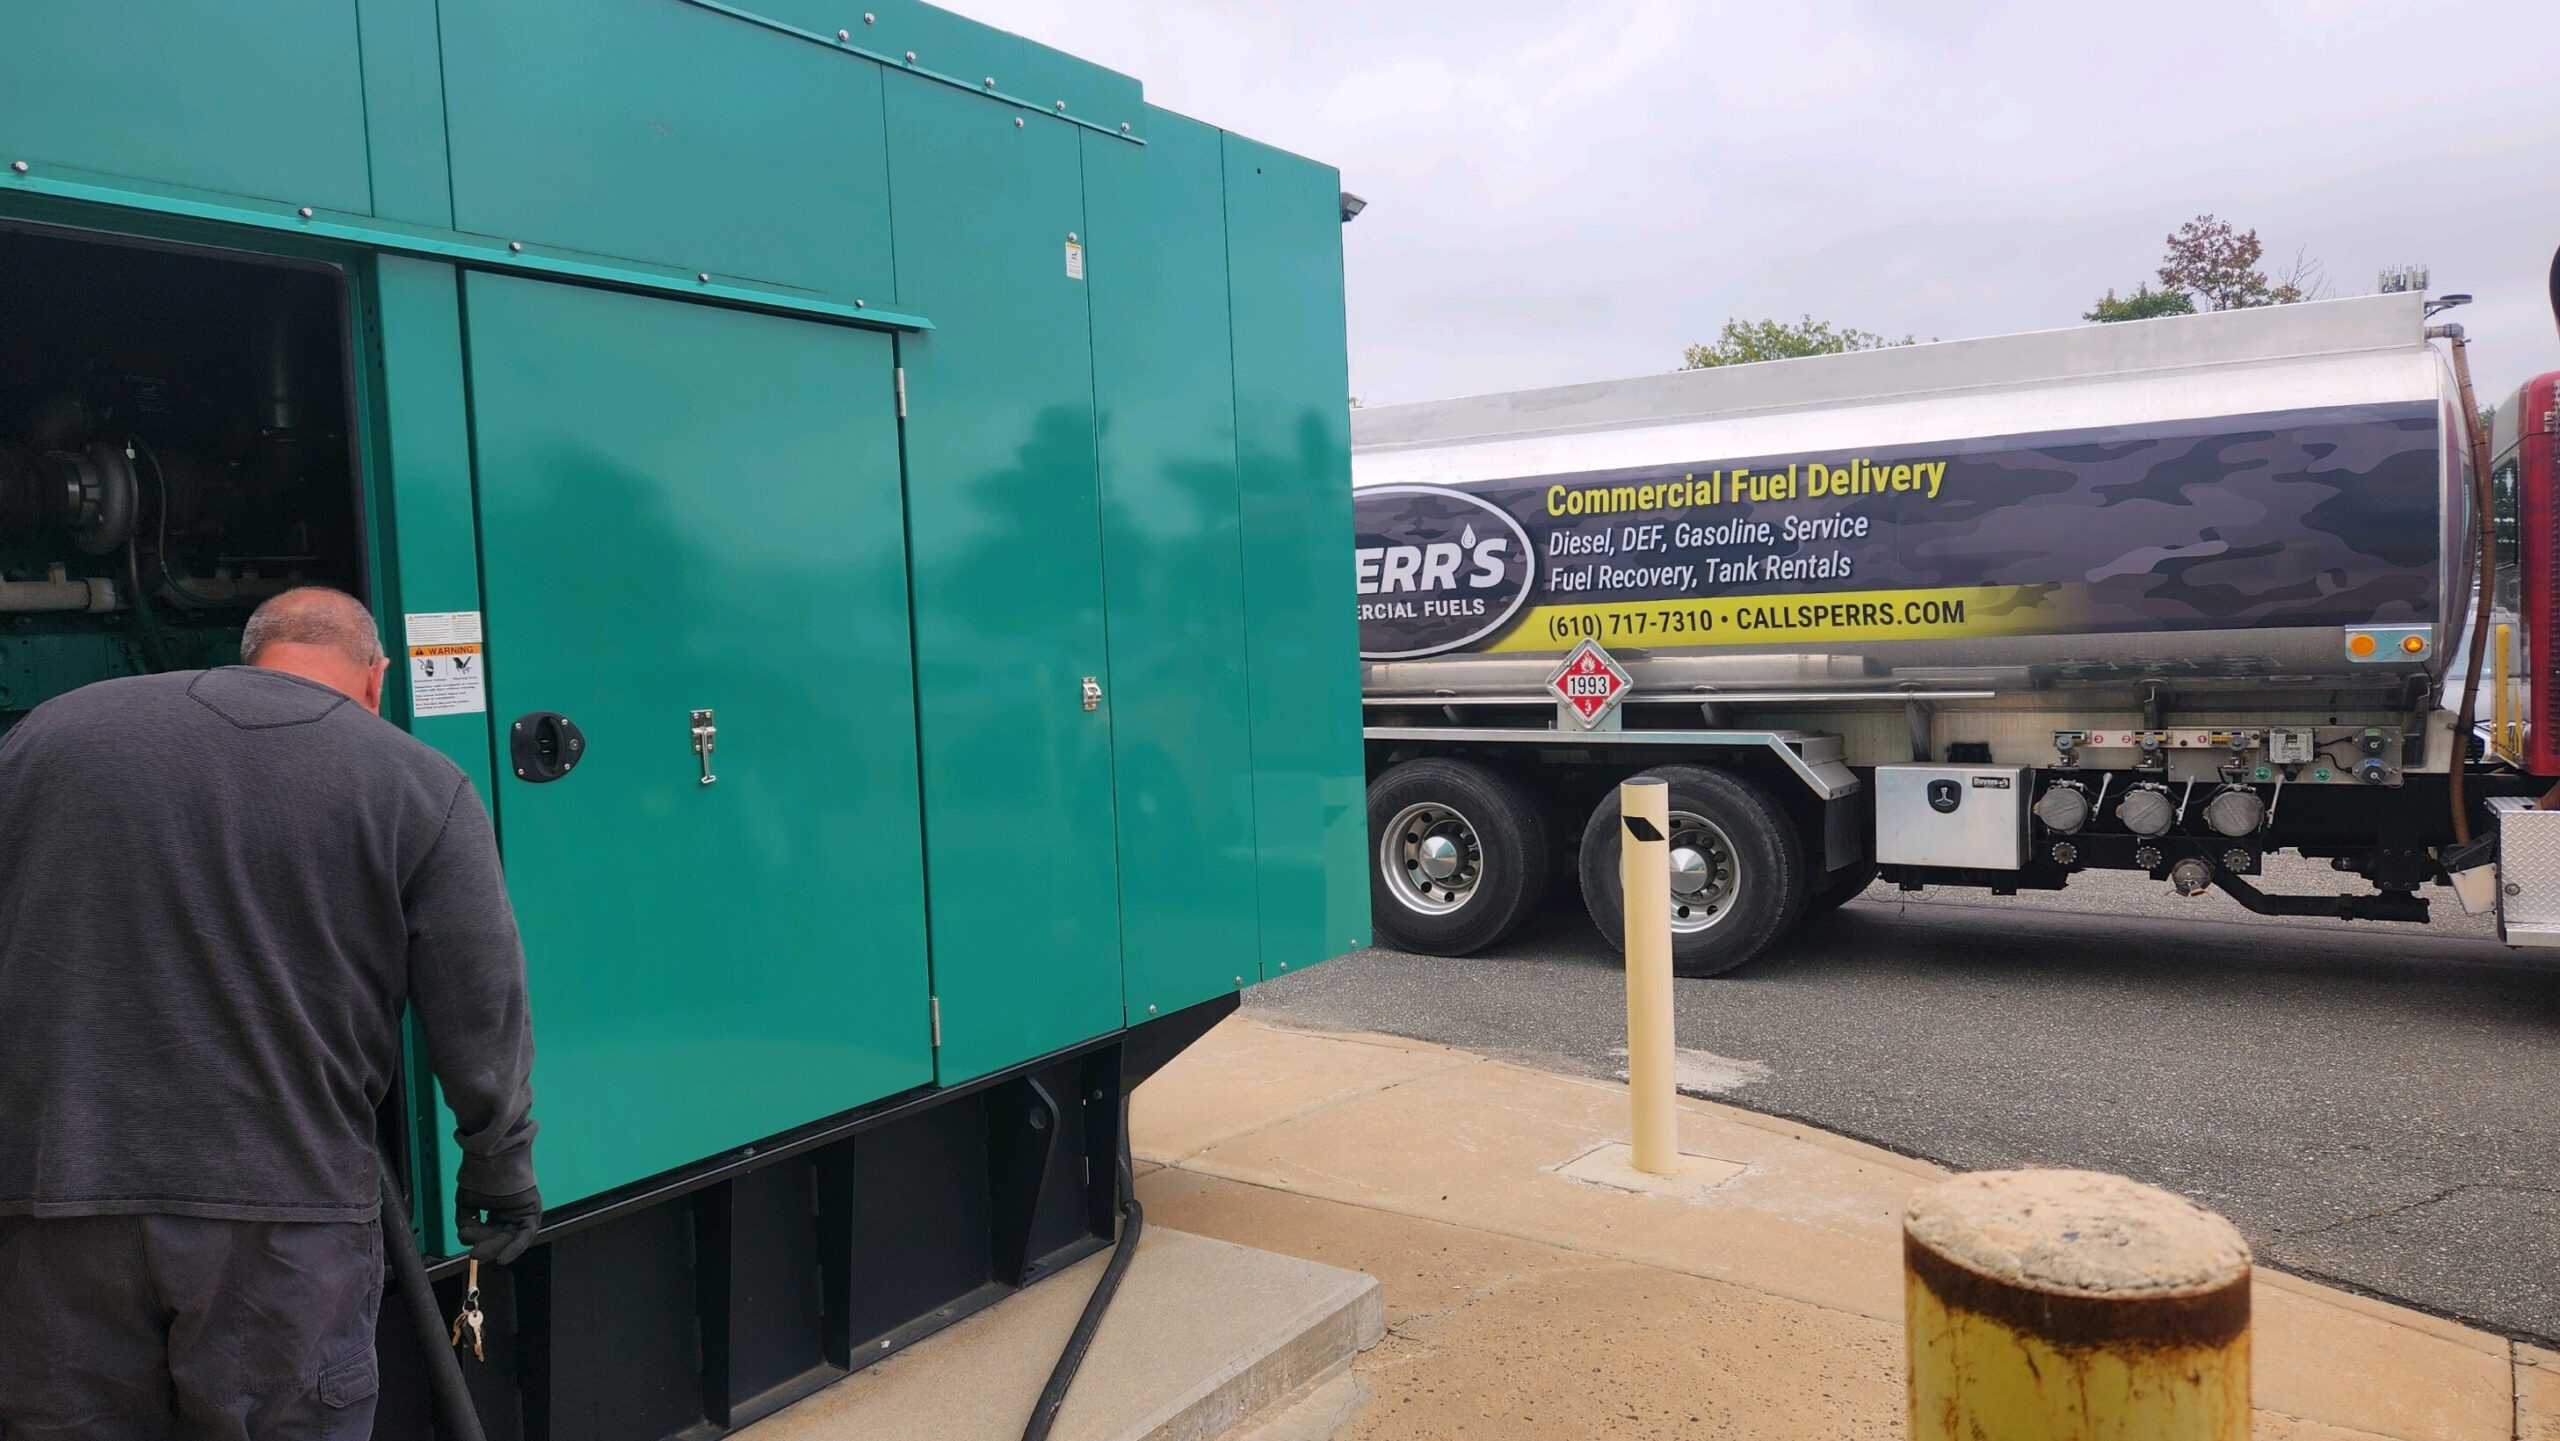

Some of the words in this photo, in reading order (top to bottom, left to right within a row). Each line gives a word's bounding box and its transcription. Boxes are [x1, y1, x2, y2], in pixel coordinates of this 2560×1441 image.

[1547, 470, 1720, 516] Commercial
[1732, 464, 1796, 502] Fuel
[1808, 459, 1946, 498] Delivery
[1549, 527, 1615, 556] Diesel,
[1622, 525, 1668, 552] DEF,
[1675, 518, 1775, 547] Gasoline,
[1783, 513, 1868, 541] Service
[1551, 565, 1593, 591] Fuel
[1599, 565, 1697, 590] Recovery,
[1706, 554, 1758, 583] Tank
[1766, 550, 1851, 580] Rentals
[1424, 598, 1485, 616] FUELS
[1549, 613, 1602, 642] (610)
[1609, 609, 1712, 635] 717-7310
[1736, 600, 1965, 630] CALLSPERRS.COM
[428, 646, 473, 656] WARNING
[1570, 676, 1607, 695] 1993
